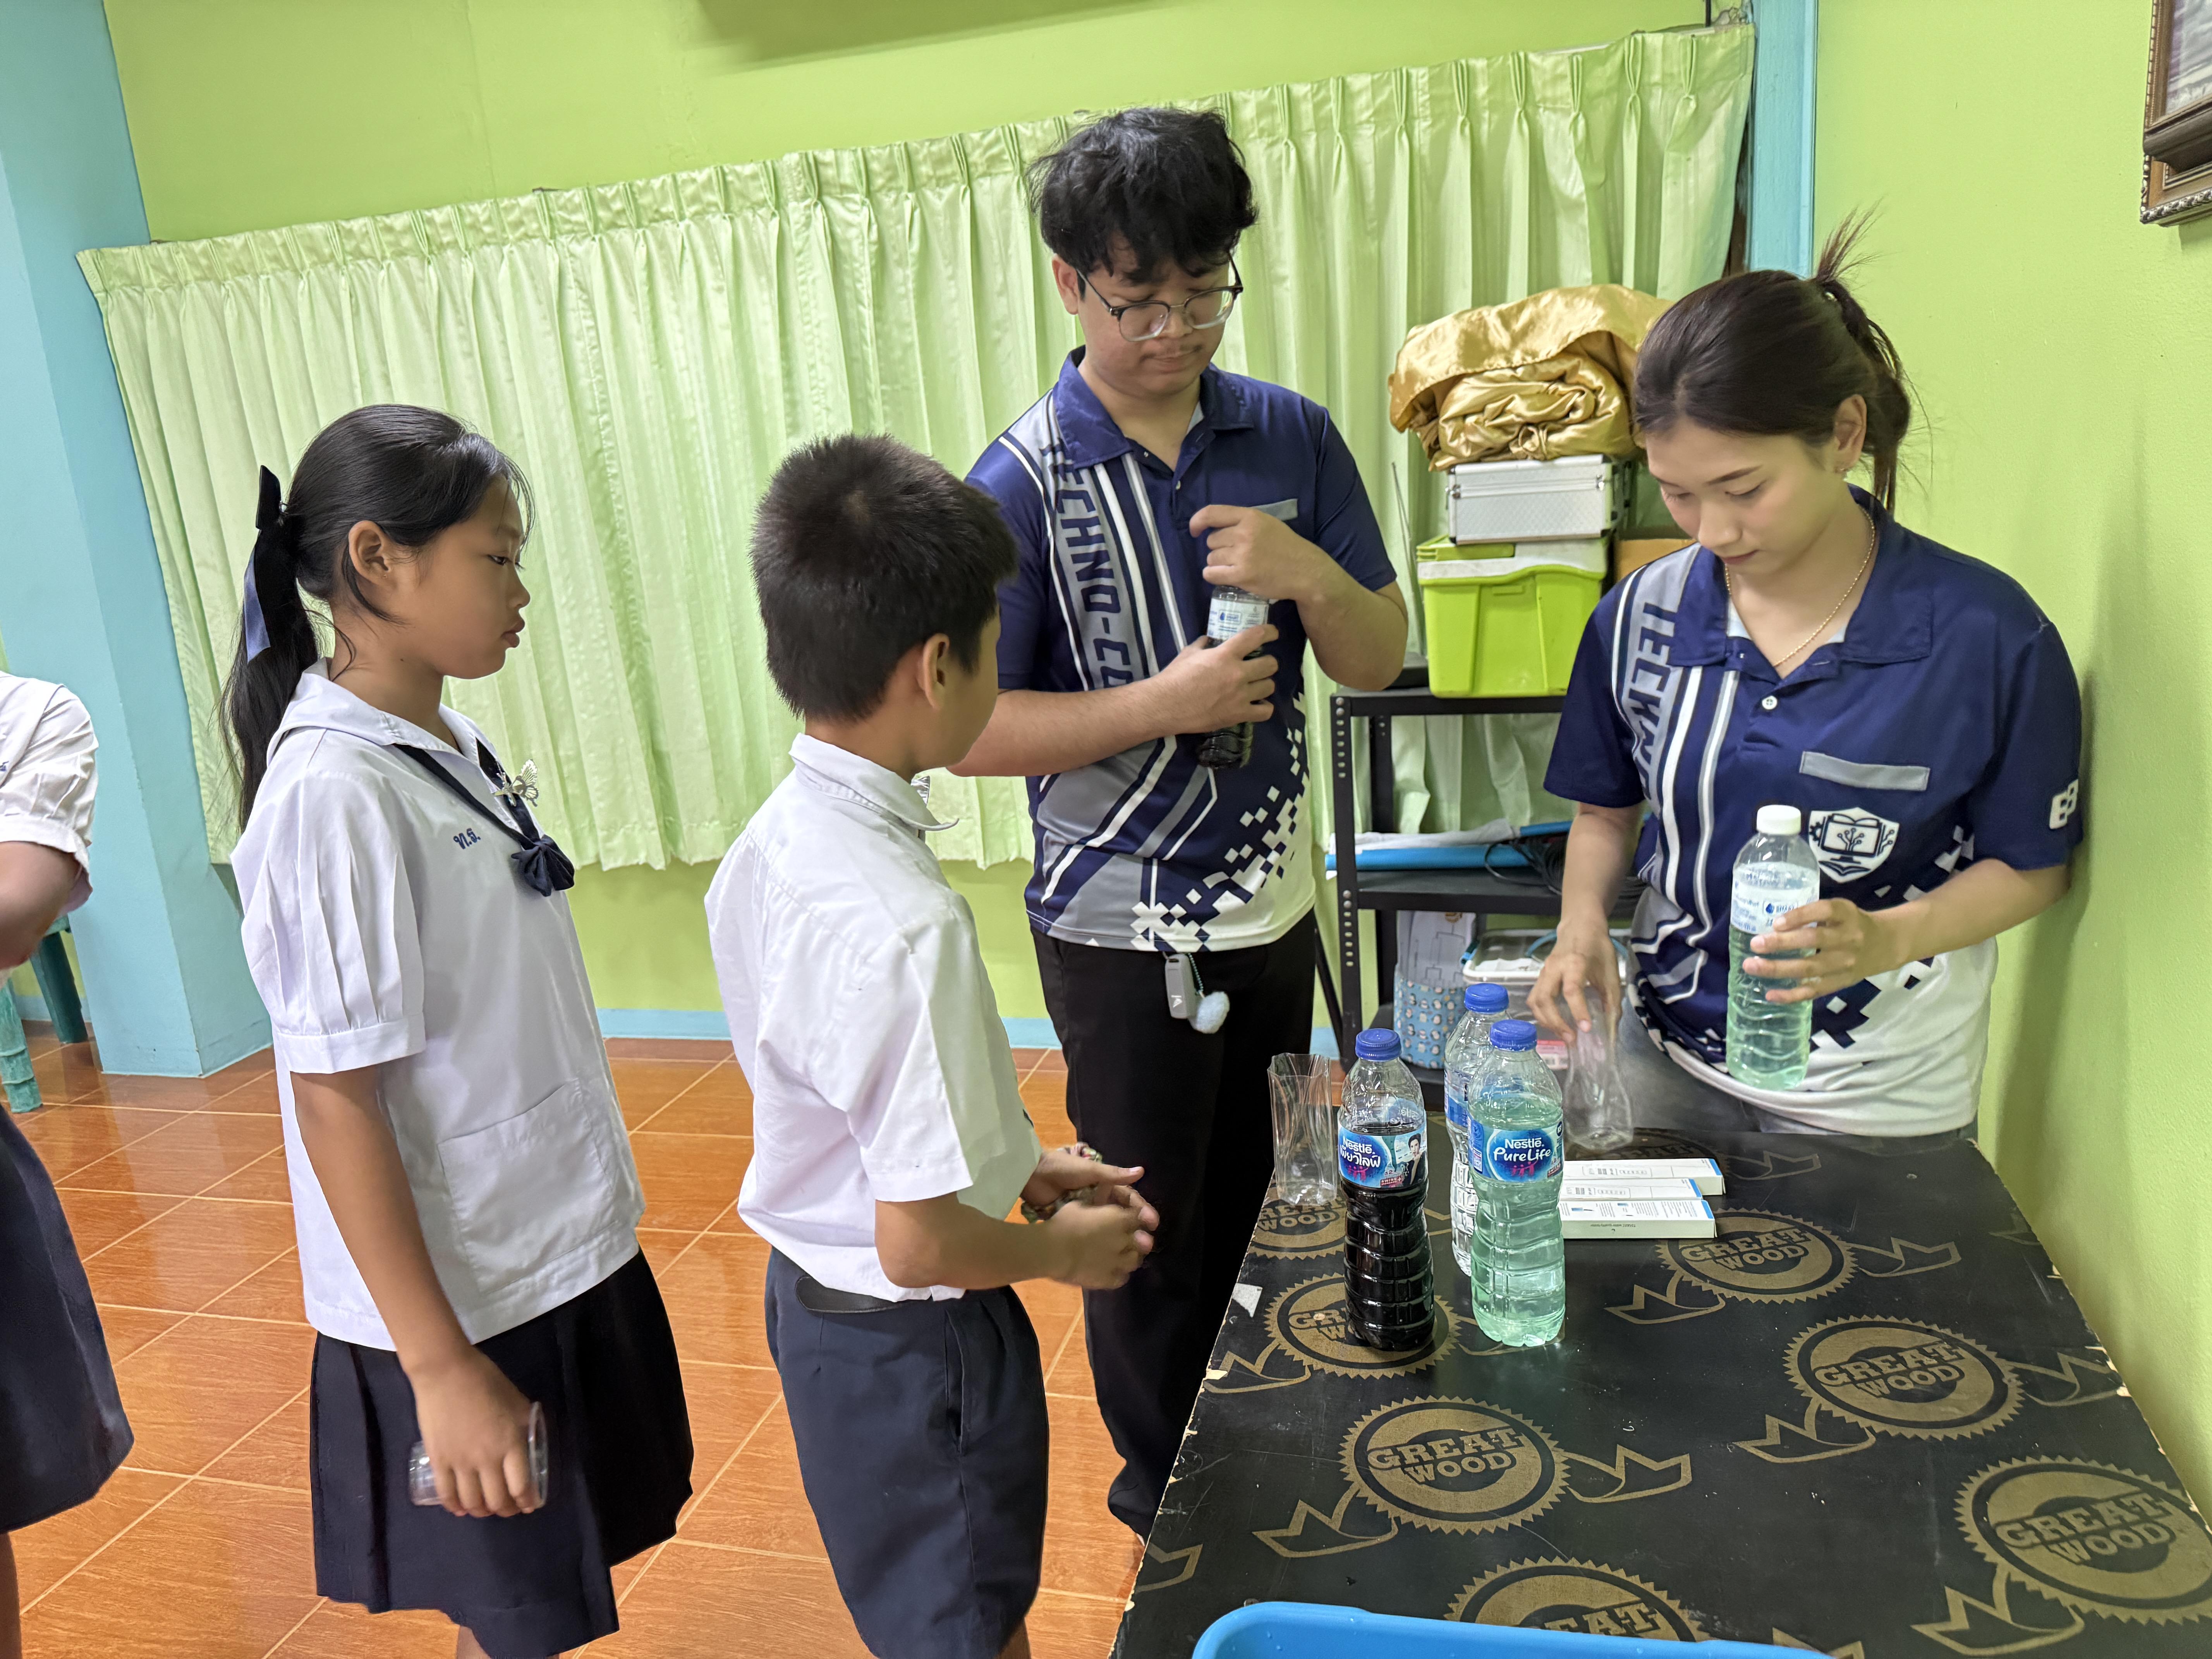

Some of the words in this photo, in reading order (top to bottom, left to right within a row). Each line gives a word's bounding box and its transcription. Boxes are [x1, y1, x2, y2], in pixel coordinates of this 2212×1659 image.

[1505, 1137, 1542, 1149] Nestlé
[1259, 1211, 1336, 1231] WOOD
[1681, 1228, 1813, 1261] GREAT
[1716, 1245, 1805, 1270] WOOD
[1815, 1342, 1966, 1386] GREAT
[1856, 1365, 1960, 1395] WOOD
[1368, 1428, 1525, 1470] GREAT
[1404, 1450, 1512, 1484] WOOD
[1996, 1493, 2174, 1546] GREAT
[2048, 1523, 2170, 1564] WOOD
